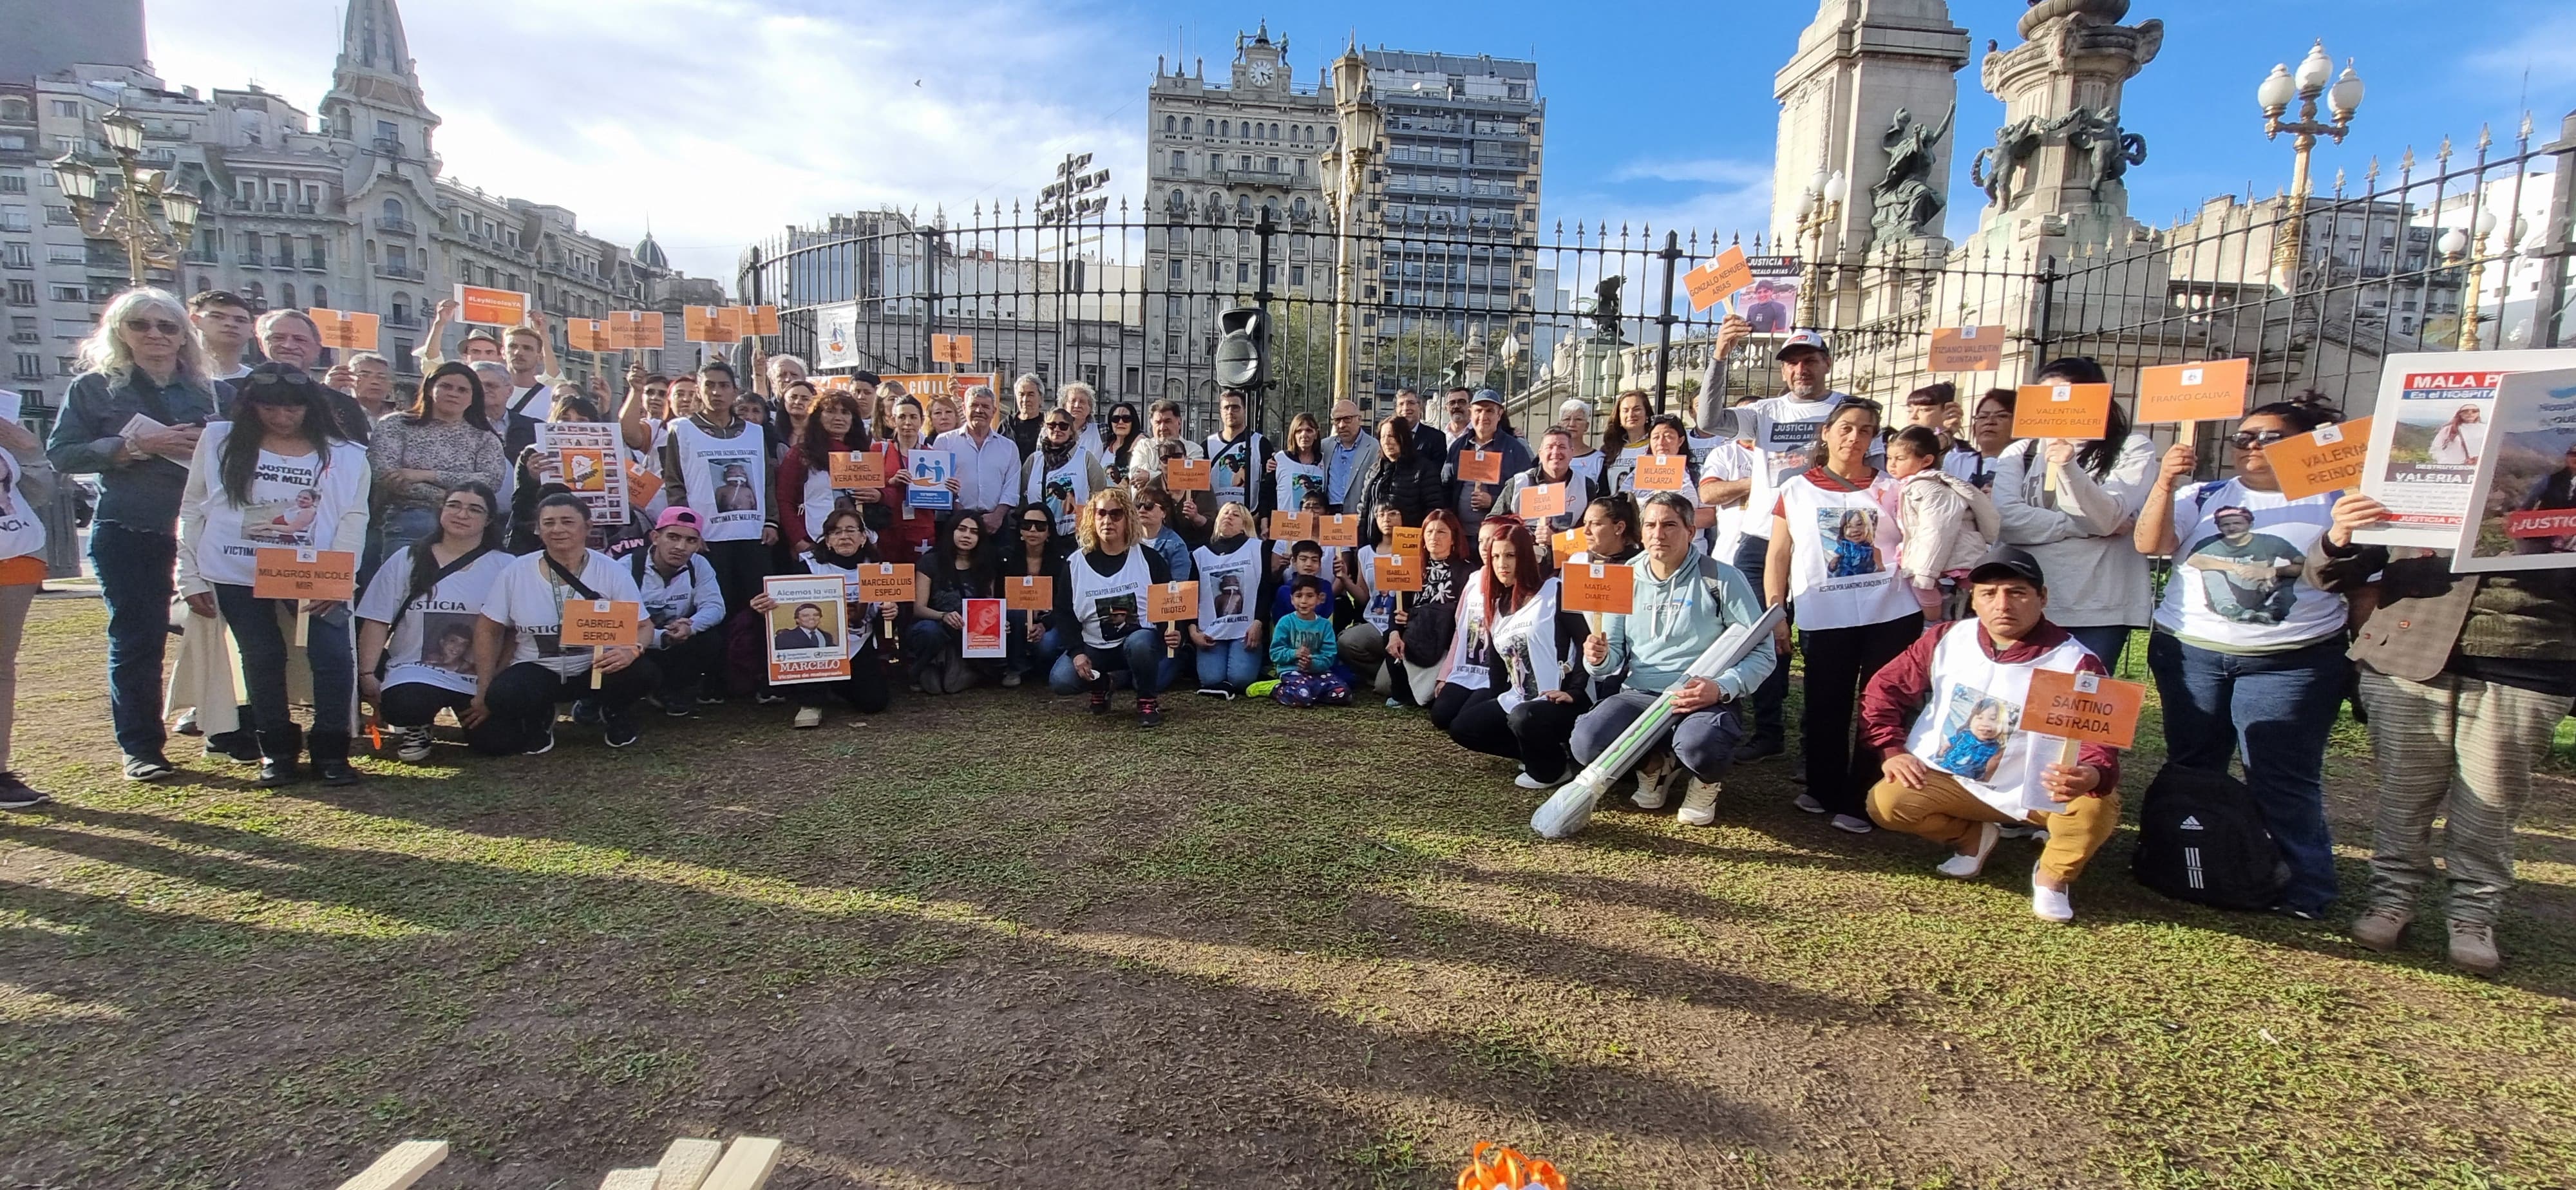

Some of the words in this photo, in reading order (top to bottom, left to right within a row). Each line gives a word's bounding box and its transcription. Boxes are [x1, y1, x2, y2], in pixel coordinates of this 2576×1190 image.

[1748, 258, 1783, 266] JUSTICIA
[1783, 257, 1790, 265] X
[1690, 276, 1720, 298] GONZALO
[1720, 260, 1746, 280] NEHUEN
[1712, 281, 1732, 296] ARIAS
[1964, 345, 2000, 353] VALENTIN
[2413, 374, 2477, 388] MALA
[909, 381, 944, 394] CIVIL
[2151, 393, 2191, 403] FRANCO
[2194, 391, 2231, 400] CALIVA
[2410, 390, 2426, 399] En
[2429, 390, 2441, 399] el
[1774, 424, 1814, 432] JUSTICIA
[258, 463, 312, 477] JUSTICIA
[255, 471, 278, 482] POR
[281, 476, 313, 486] MILI
[834, 474, 852, 482] VERA
[853, 473, 881, 482] SANDEZ
[2395, 472, 2462, 484] VALERIA
[2398, 515, 2446, 523] JUSTICIA
[258, 567, 311, 578] MILAGROS
[314, 571, 350, 580] NICOLE
[296, 581, 314, 590] MIR
[861, 578, 895, 586] MARCELO
[1084, 589, 1101, 598] JUSTICIA
[1108, 585, 1122, 594] JAVIER
[1122, 581, 1139, 592] TIMOTEO
[1819, 584, 1835, 593] JUSTICIA
[1585, 592, 1611, 601] DIARTE
[576, 618, 624, 629] GABRIELA
[583, 631, 616, 641] BERON
[779, 659, 840, 672] MARCELO
[2051, 695, 2113, 716] SANTINO
[2045, 712, 2110, 735] ESTRADA
